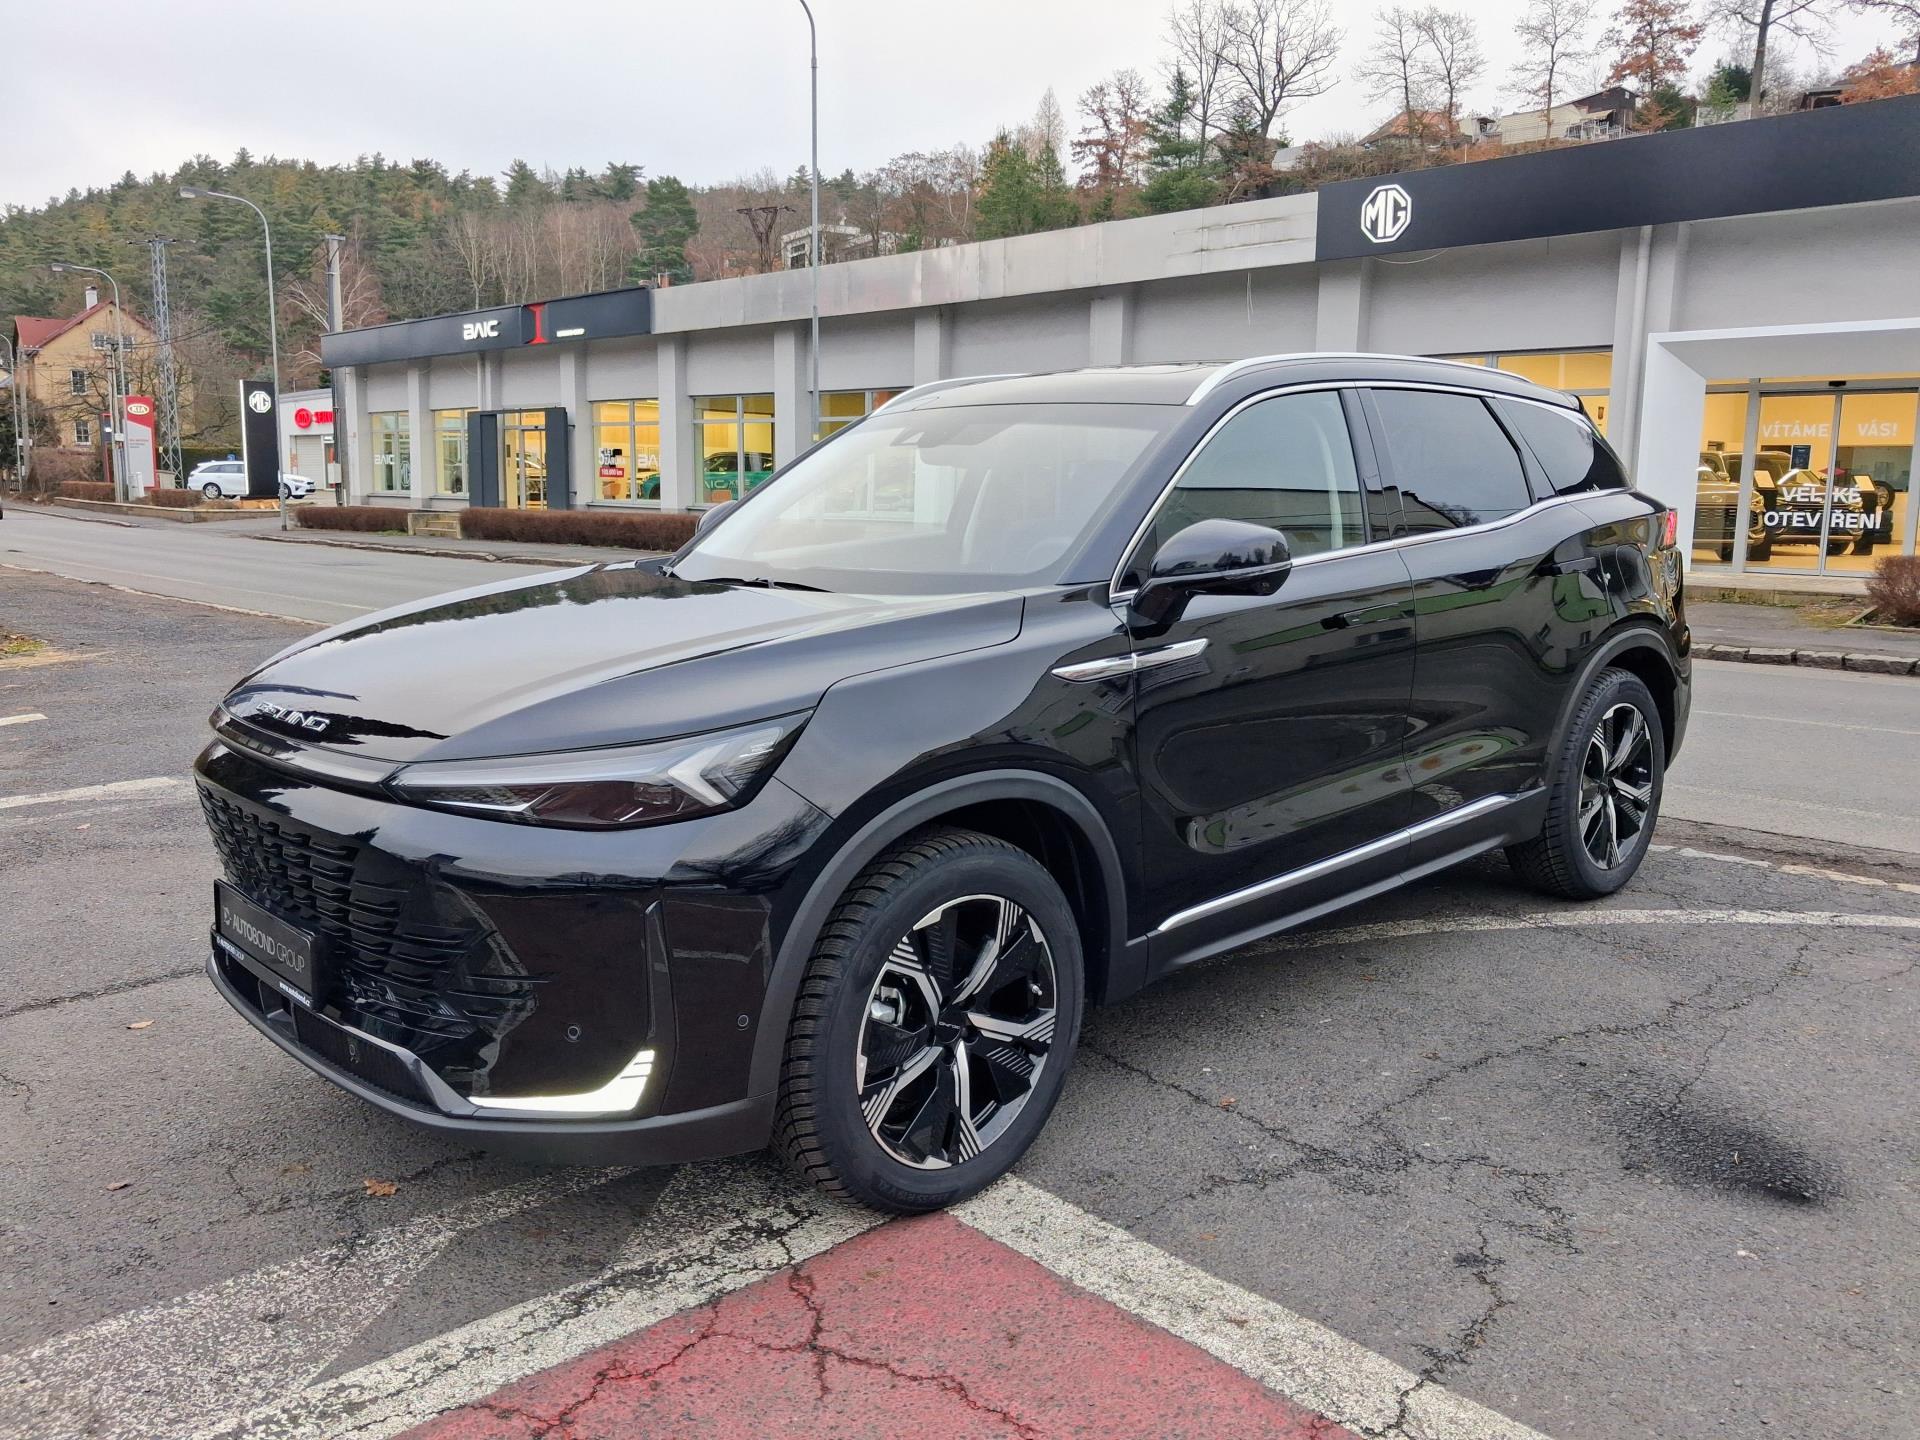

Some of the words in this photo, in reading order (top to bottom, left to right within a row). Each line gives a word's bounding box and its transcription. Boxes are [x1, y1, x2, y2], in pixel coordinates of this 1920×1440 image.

[1363, 187, 1409, 240] MG
[463, 320, 499, 340] BAIC
[250, 392, 270, 412] MG
[1762, 421, 1830, 437] VÍTÁME
[1857, 420, 1898, 437] VÁS!
[374, 454, 395, 465] BAIC
[232, 914, 275, 956] AUTOBOND
[276, 942, 305, 973] GROUP
